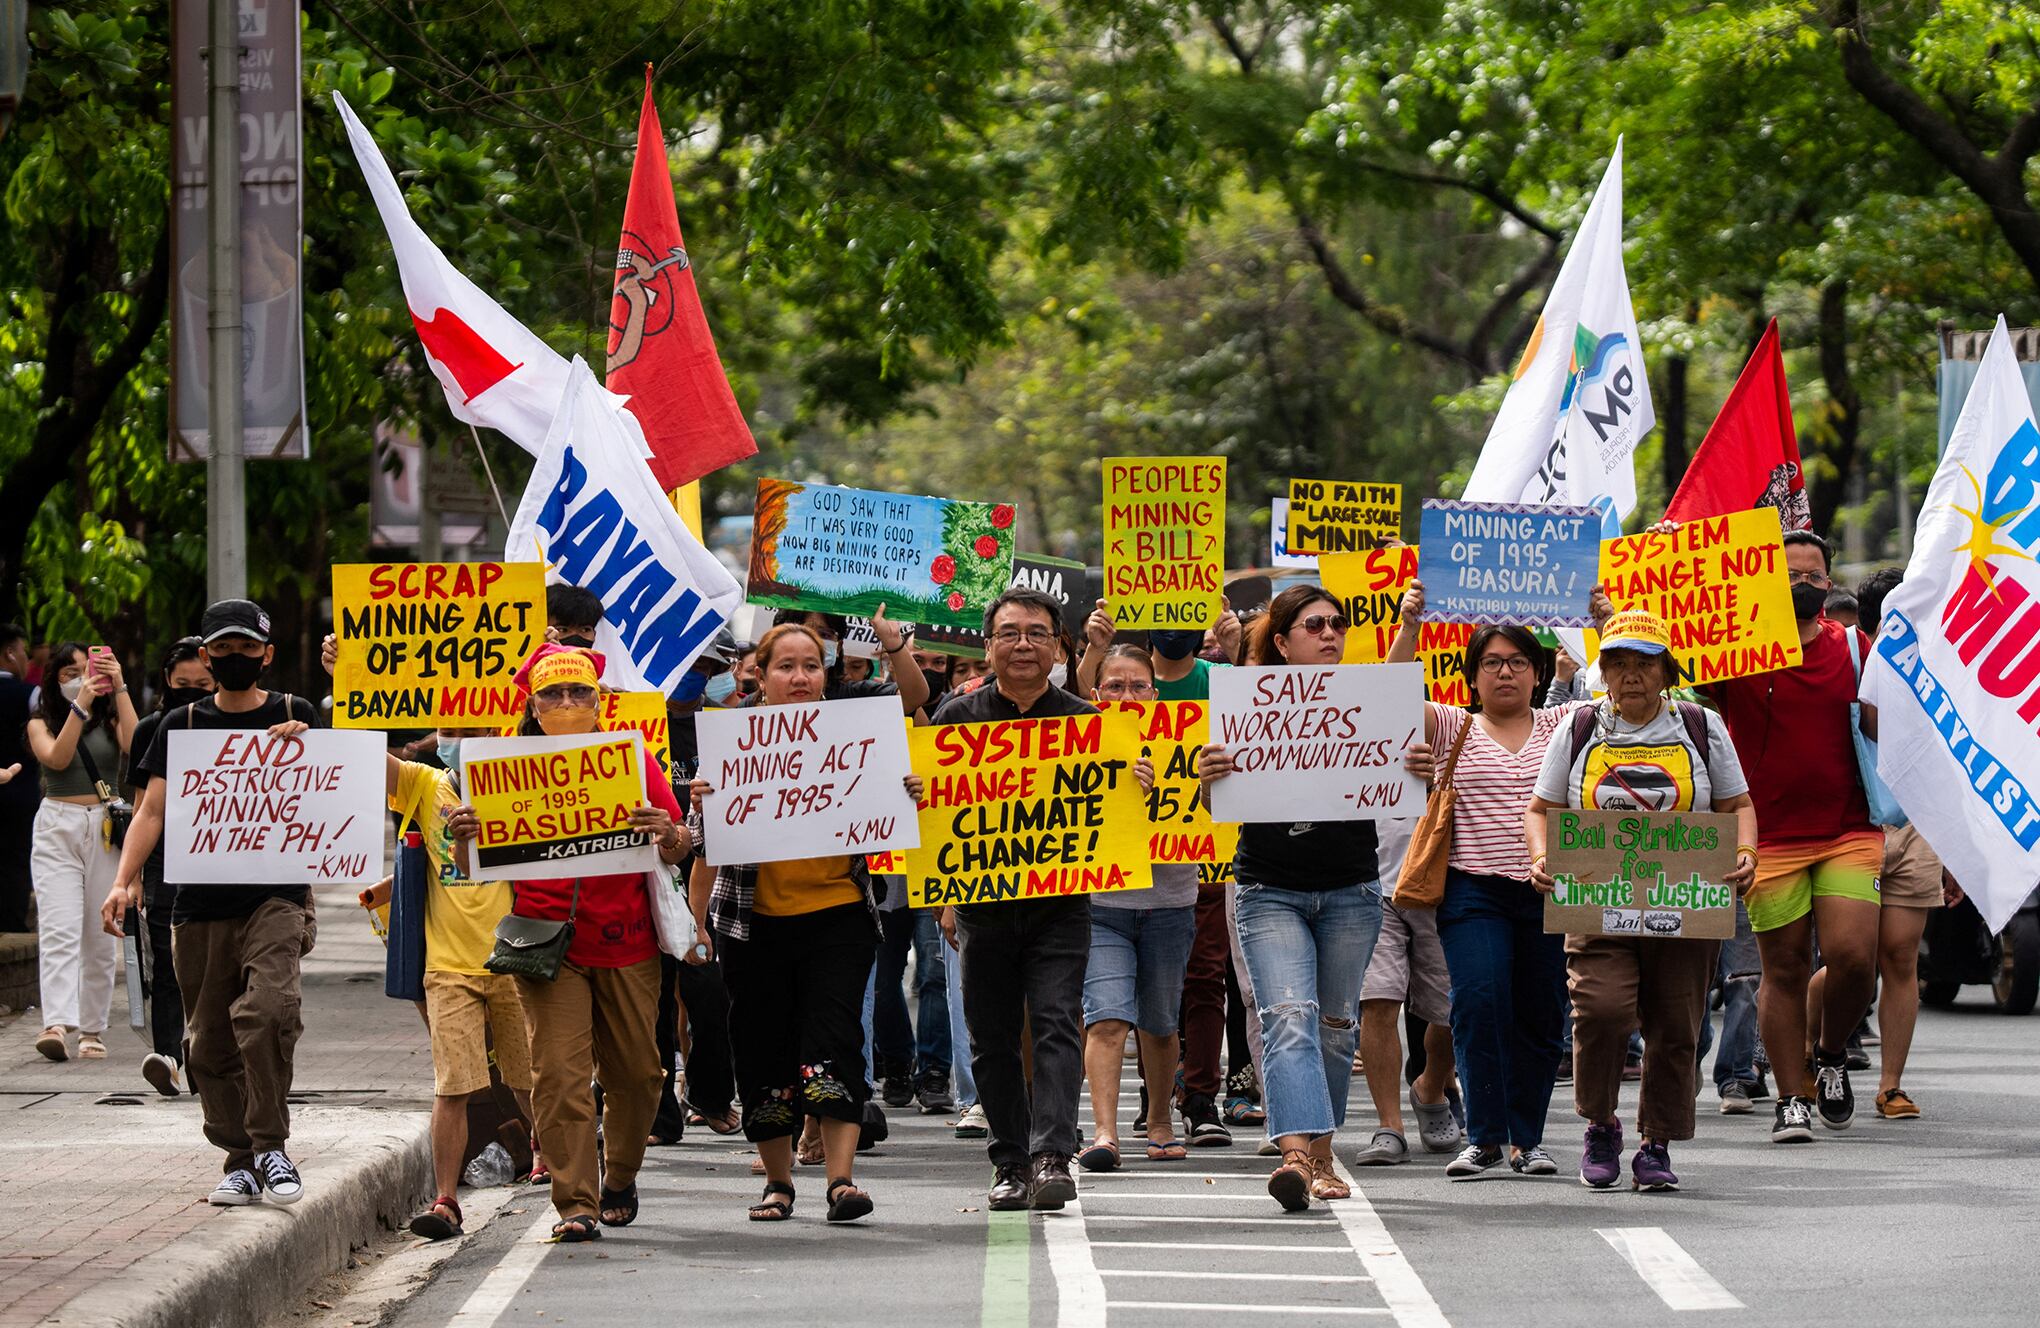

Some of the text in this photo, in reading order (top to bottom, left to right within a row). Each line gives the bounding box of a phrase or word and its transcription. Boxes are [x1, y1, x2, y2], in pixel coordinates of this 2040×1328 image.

[1112, 464, 1222, 494] PEOPLE'S
[1293, 483, 1396, 505] NO FAITH
[813, 490, 912, 521] GOD SAW THAT
[1111, 501, 1213, 531] MINING
[1308, 505, 1401, 527] LARGE-SCALE
[805, 517, 914, 544] IT WAS VERY GOOD
[1445, 512, 1584, 541] MINING ACT
[1609, 516, 1730, 568] SYSTEM
[782, 535, 921, 566] NOW BIG MINING CORPS
[1136, 529, 1203, 562] BILL
[1451, 542, 1482, 566] OF
[369, 562, 504, 600] SCRAP
[536, 443, 725, 689] BAYAN
[795, 555, 908, 582] ARE DESTROYING IT
[1108, 563, 1218, 596] ISABATAS
[1604, 543, 1780, 601] HANGE NOT
[342, 601, 533, 640] MINING ACT
[1115, 601, 1208, 623] AY ENGG
[1619, 615, 1658, 626] MINING
[1670, 602, 1759, 650] ANGE!
[366, 641, 408, 676] OF
[1701, 641, 1798, 682] MUNA-
[438, 686, 527, 717] MUNA
[1253, 671, 1336, 707] SAVE
[737, 708, 821, 751] JUNK
[935, 714, 1102, 767] SYSTEM
[1221, 706, 1362, 744] WORKERS
[1882, 612, 2040, 838] PARTYLIST
[214, 733, 305, 768] END
[721, 750, 803, 790] MINING
[819, 738, 876, 774] ACT
[180, 764, 345, 797] DESTRUCTIVE
[469, 753, 570, 797] MINING
[579, 742, 632, 784] ACT
[916, 759, 1128, 811] HANGE NOT
[192, 794, 302, 827] MINING
[511, 787, 590, 814] OF 1995
[725, 793, 764, 826] OF
[1344, 781, 1404, 809] -KMU
[834, 816, 896, 847] -KMU
[951, 794, 1104, 840] CLIMATE
[1559, 812, 1719, 852] Bai Strikes
[189, 827, 224, 854] IN
[226, 825, 271, 852] THE
[540, 833, 644, 860] -KATRIBU
[936, 830, 1100, 876] CHANGE!
[307, 853, 368, 878] -KMU
[1620, 850, 1663, 881] for
[1551, 871, 1732, 910] Climate Justice
